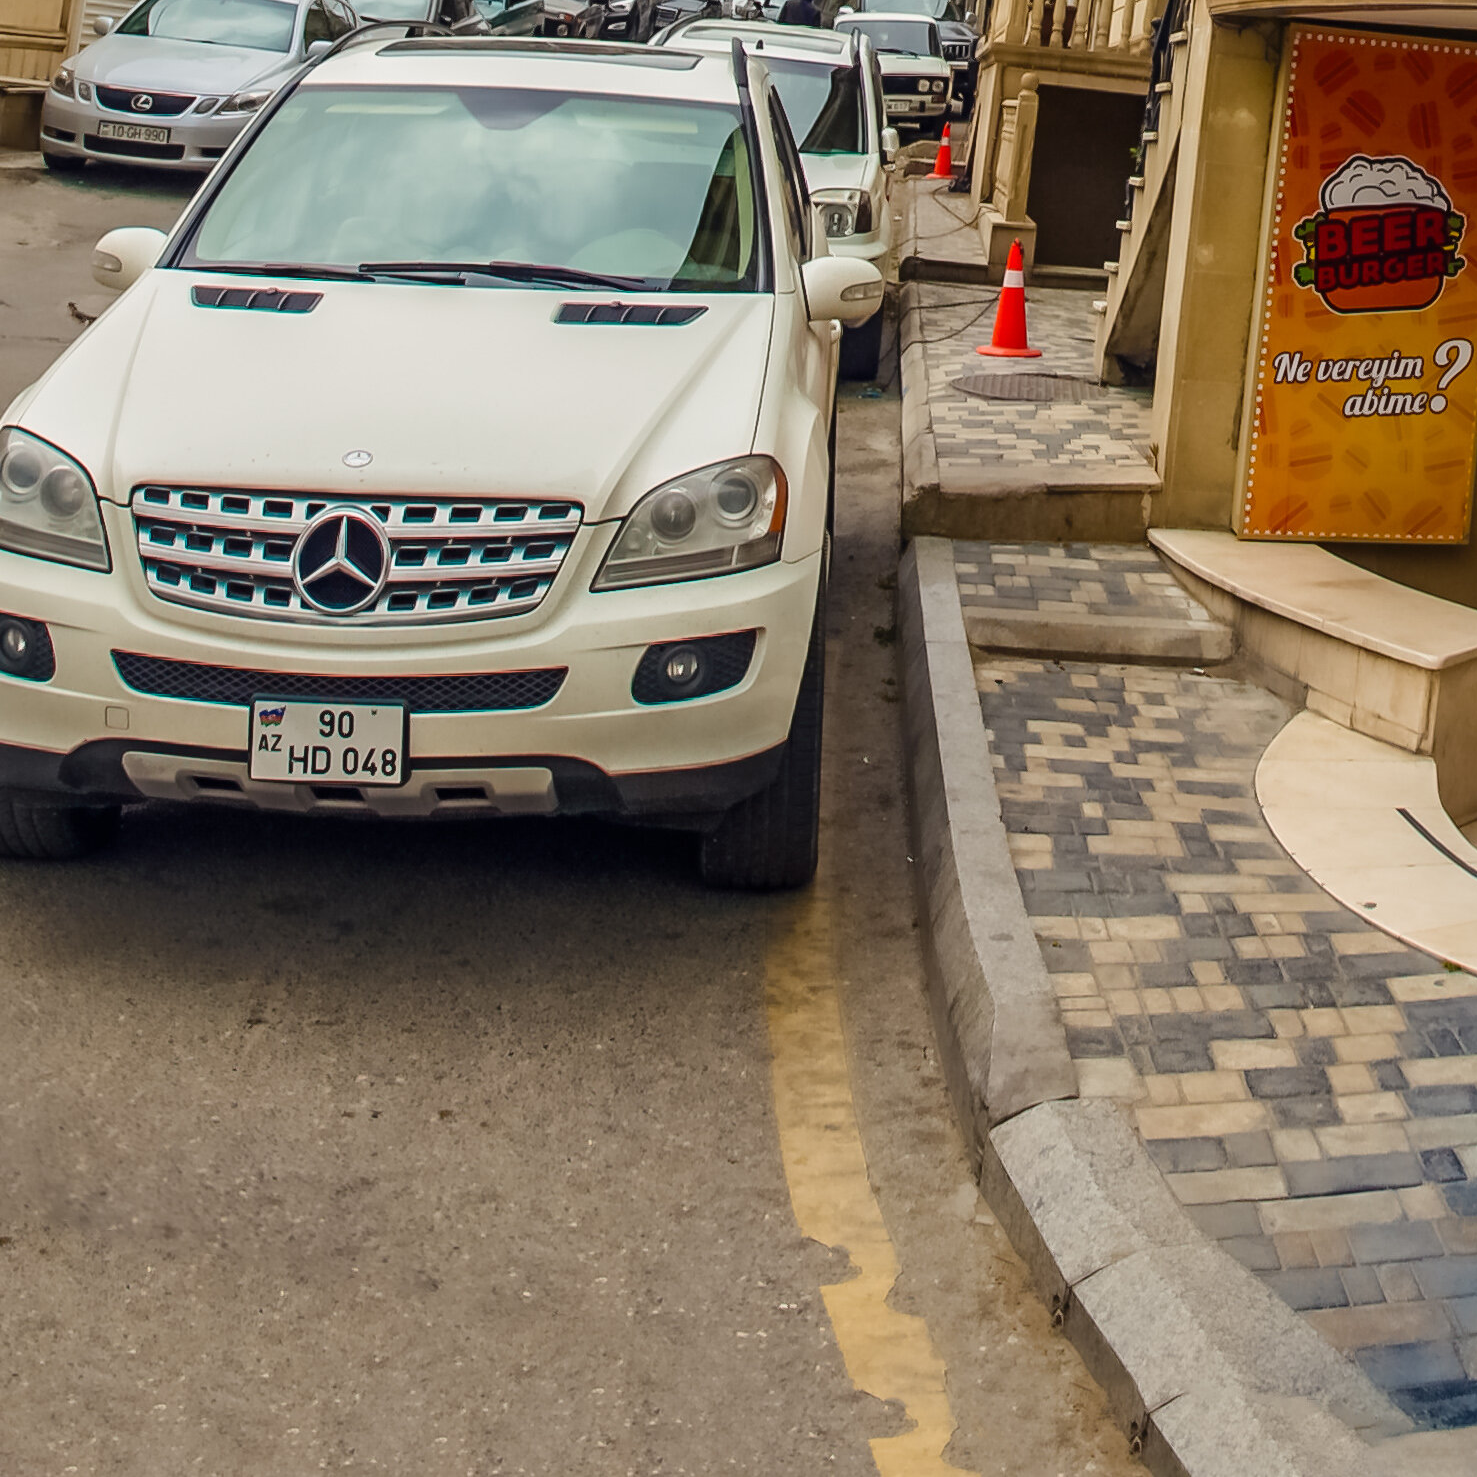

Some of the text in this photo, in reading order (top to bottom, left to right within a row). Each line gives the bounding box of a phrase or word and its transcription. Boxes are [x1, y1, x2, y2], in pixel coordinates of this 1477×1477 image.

[1317, 211, 1447, 261] BEER
[1317, 252, 1447, 290] BURGER
[1273, 350, 1424, 388] Ne vereyim
[1343, 386, 1428, 417] abime
[319, 709, 354, 739] 90
[258, 733, 283, 752] AZ
[288, 744, 397, 777] HD 048
